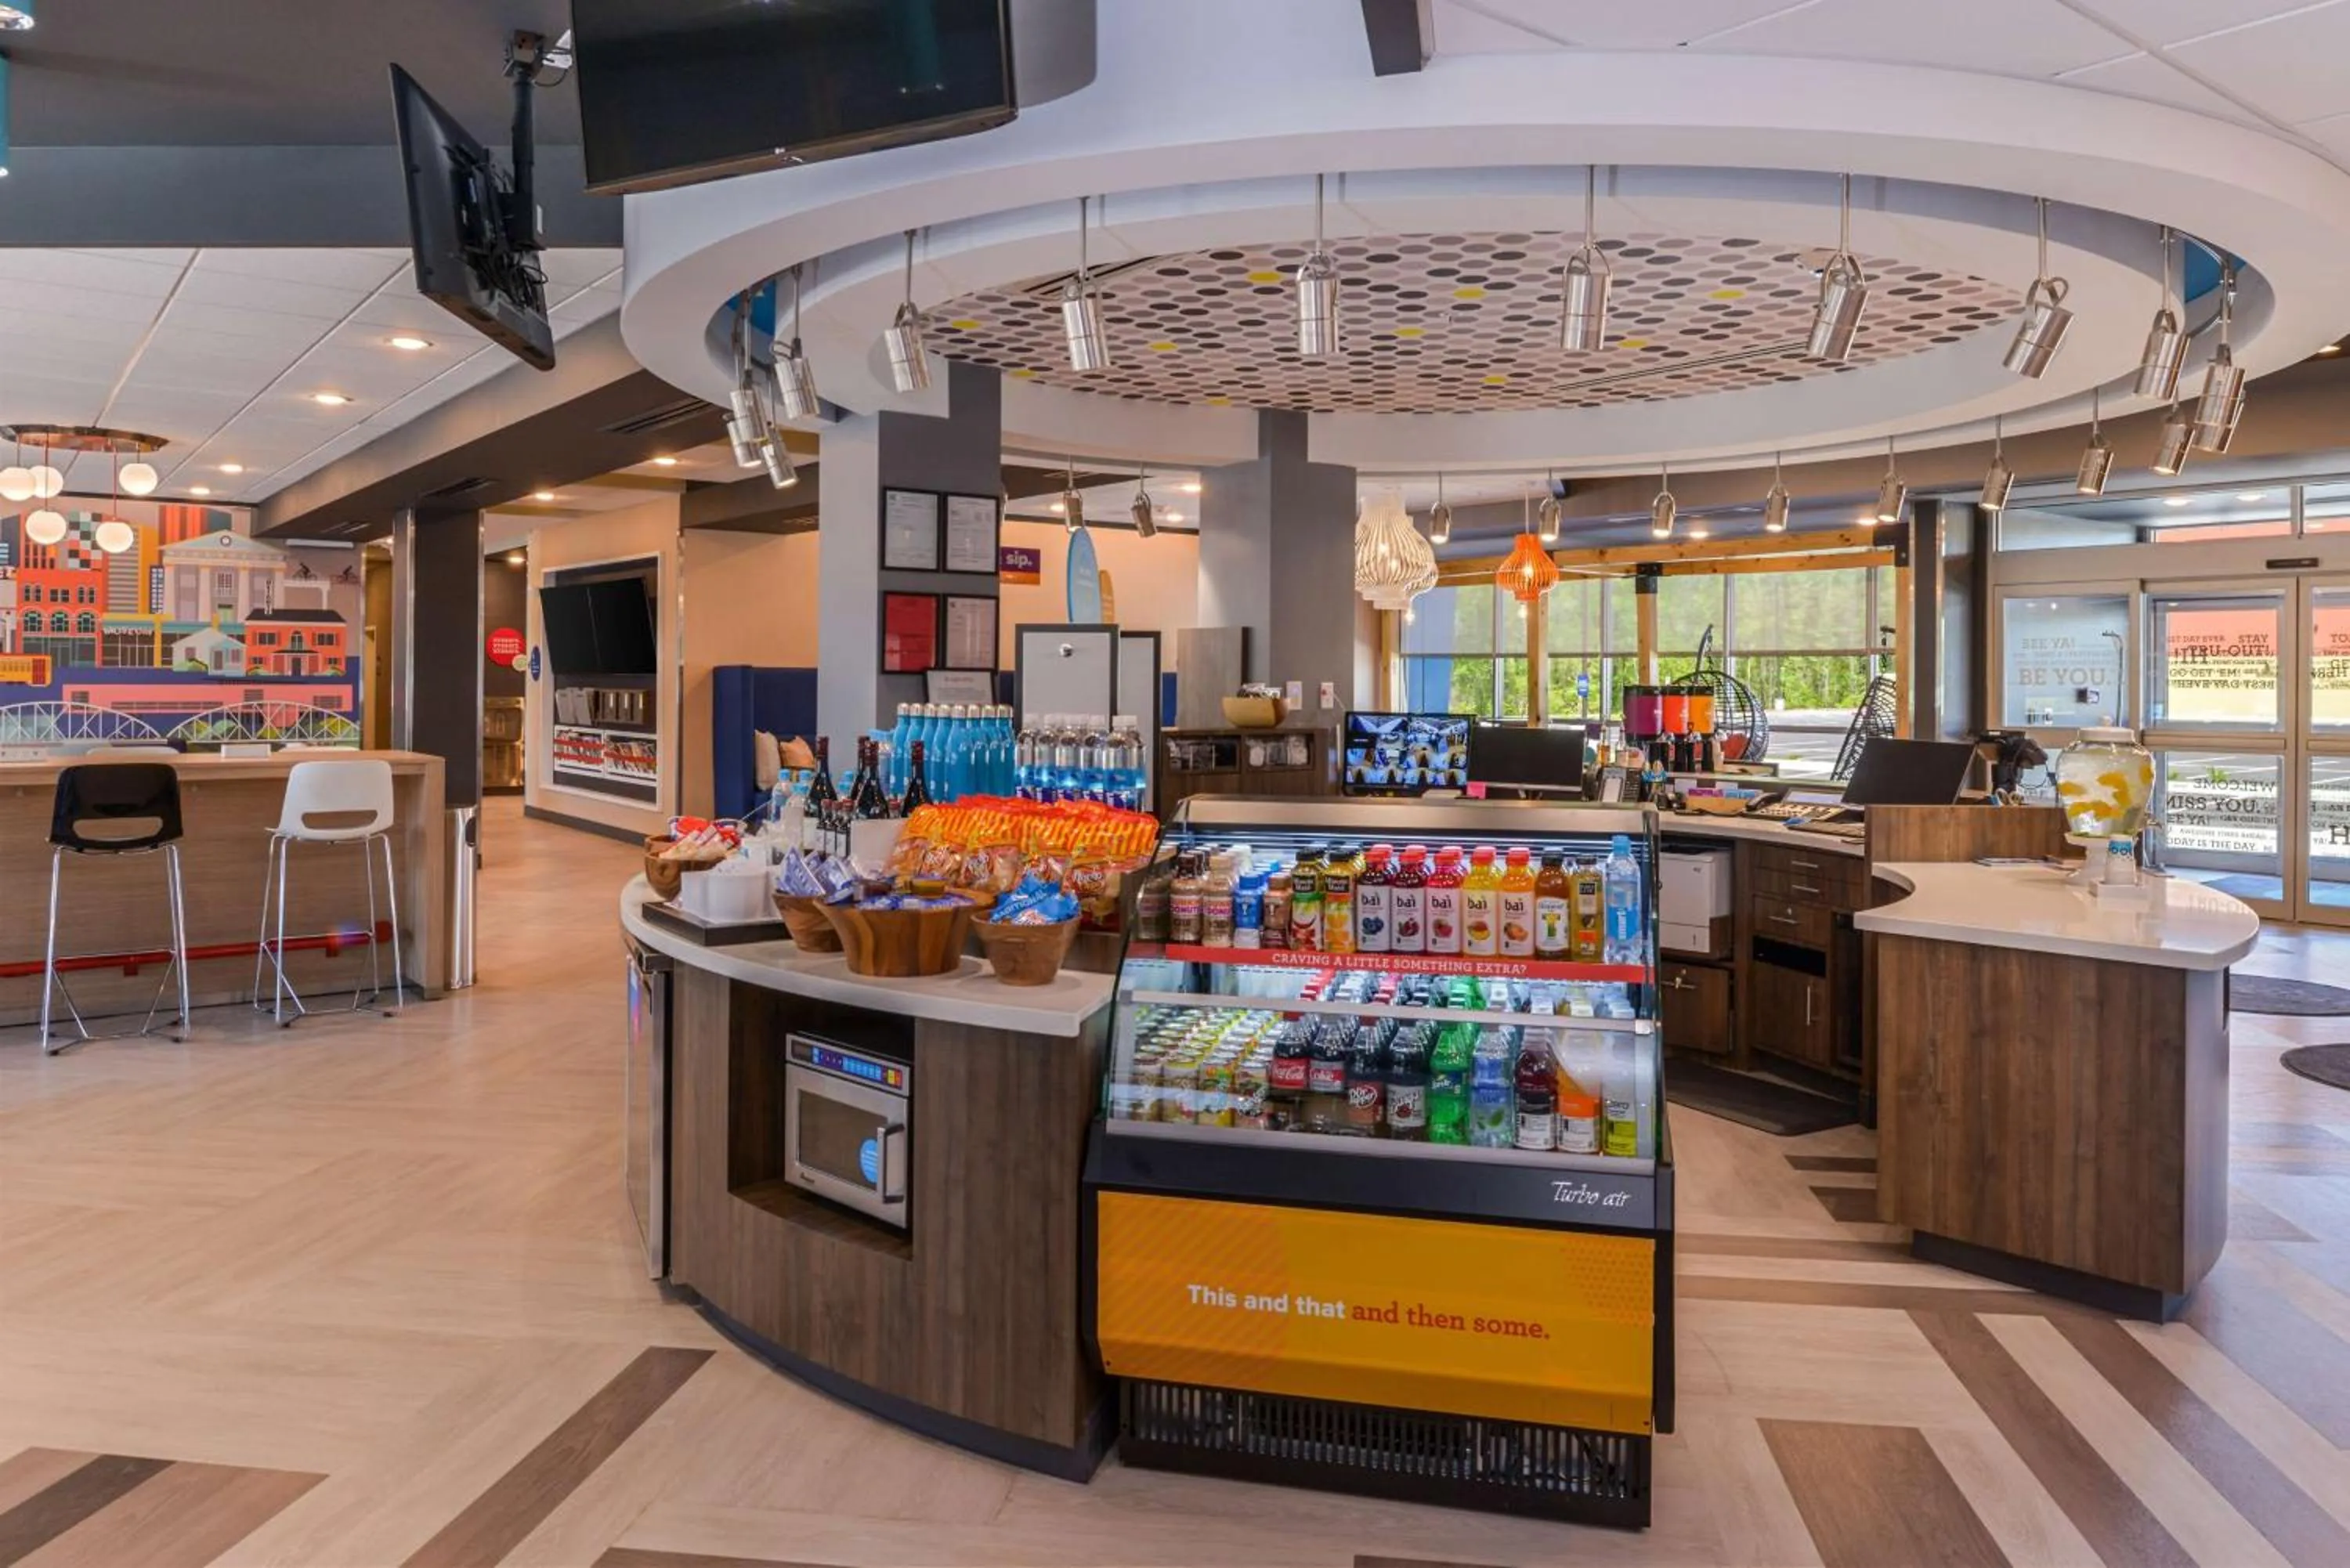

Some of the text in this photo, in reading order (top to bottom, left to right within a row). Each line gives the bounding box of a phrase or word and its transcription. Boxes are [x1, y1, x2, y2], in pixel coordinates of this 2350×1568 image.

[1006, 551, 1032, 568] sip.
[2238, 634, 2269, 643] STAY
[2018, 667, 2112, 685] BE YOU.
[2211, 797, 2261, 813] YOU.
[1361, 891, 1380, 906] bai
[1397, 894, 1416, 908] bai
[1432, 894, 1452, 909] bai
[1467, 895, 1488, 910] bai
[1505, 898, 1524, 911] bai
[1272, 953, 1527, 974] CRAVING A LITTLE SOMETHING EXTRA?
[1551, 1182, 1632, 1207] Turbo air
[1188, 1284, 1551, 1340] This and that and then some.
